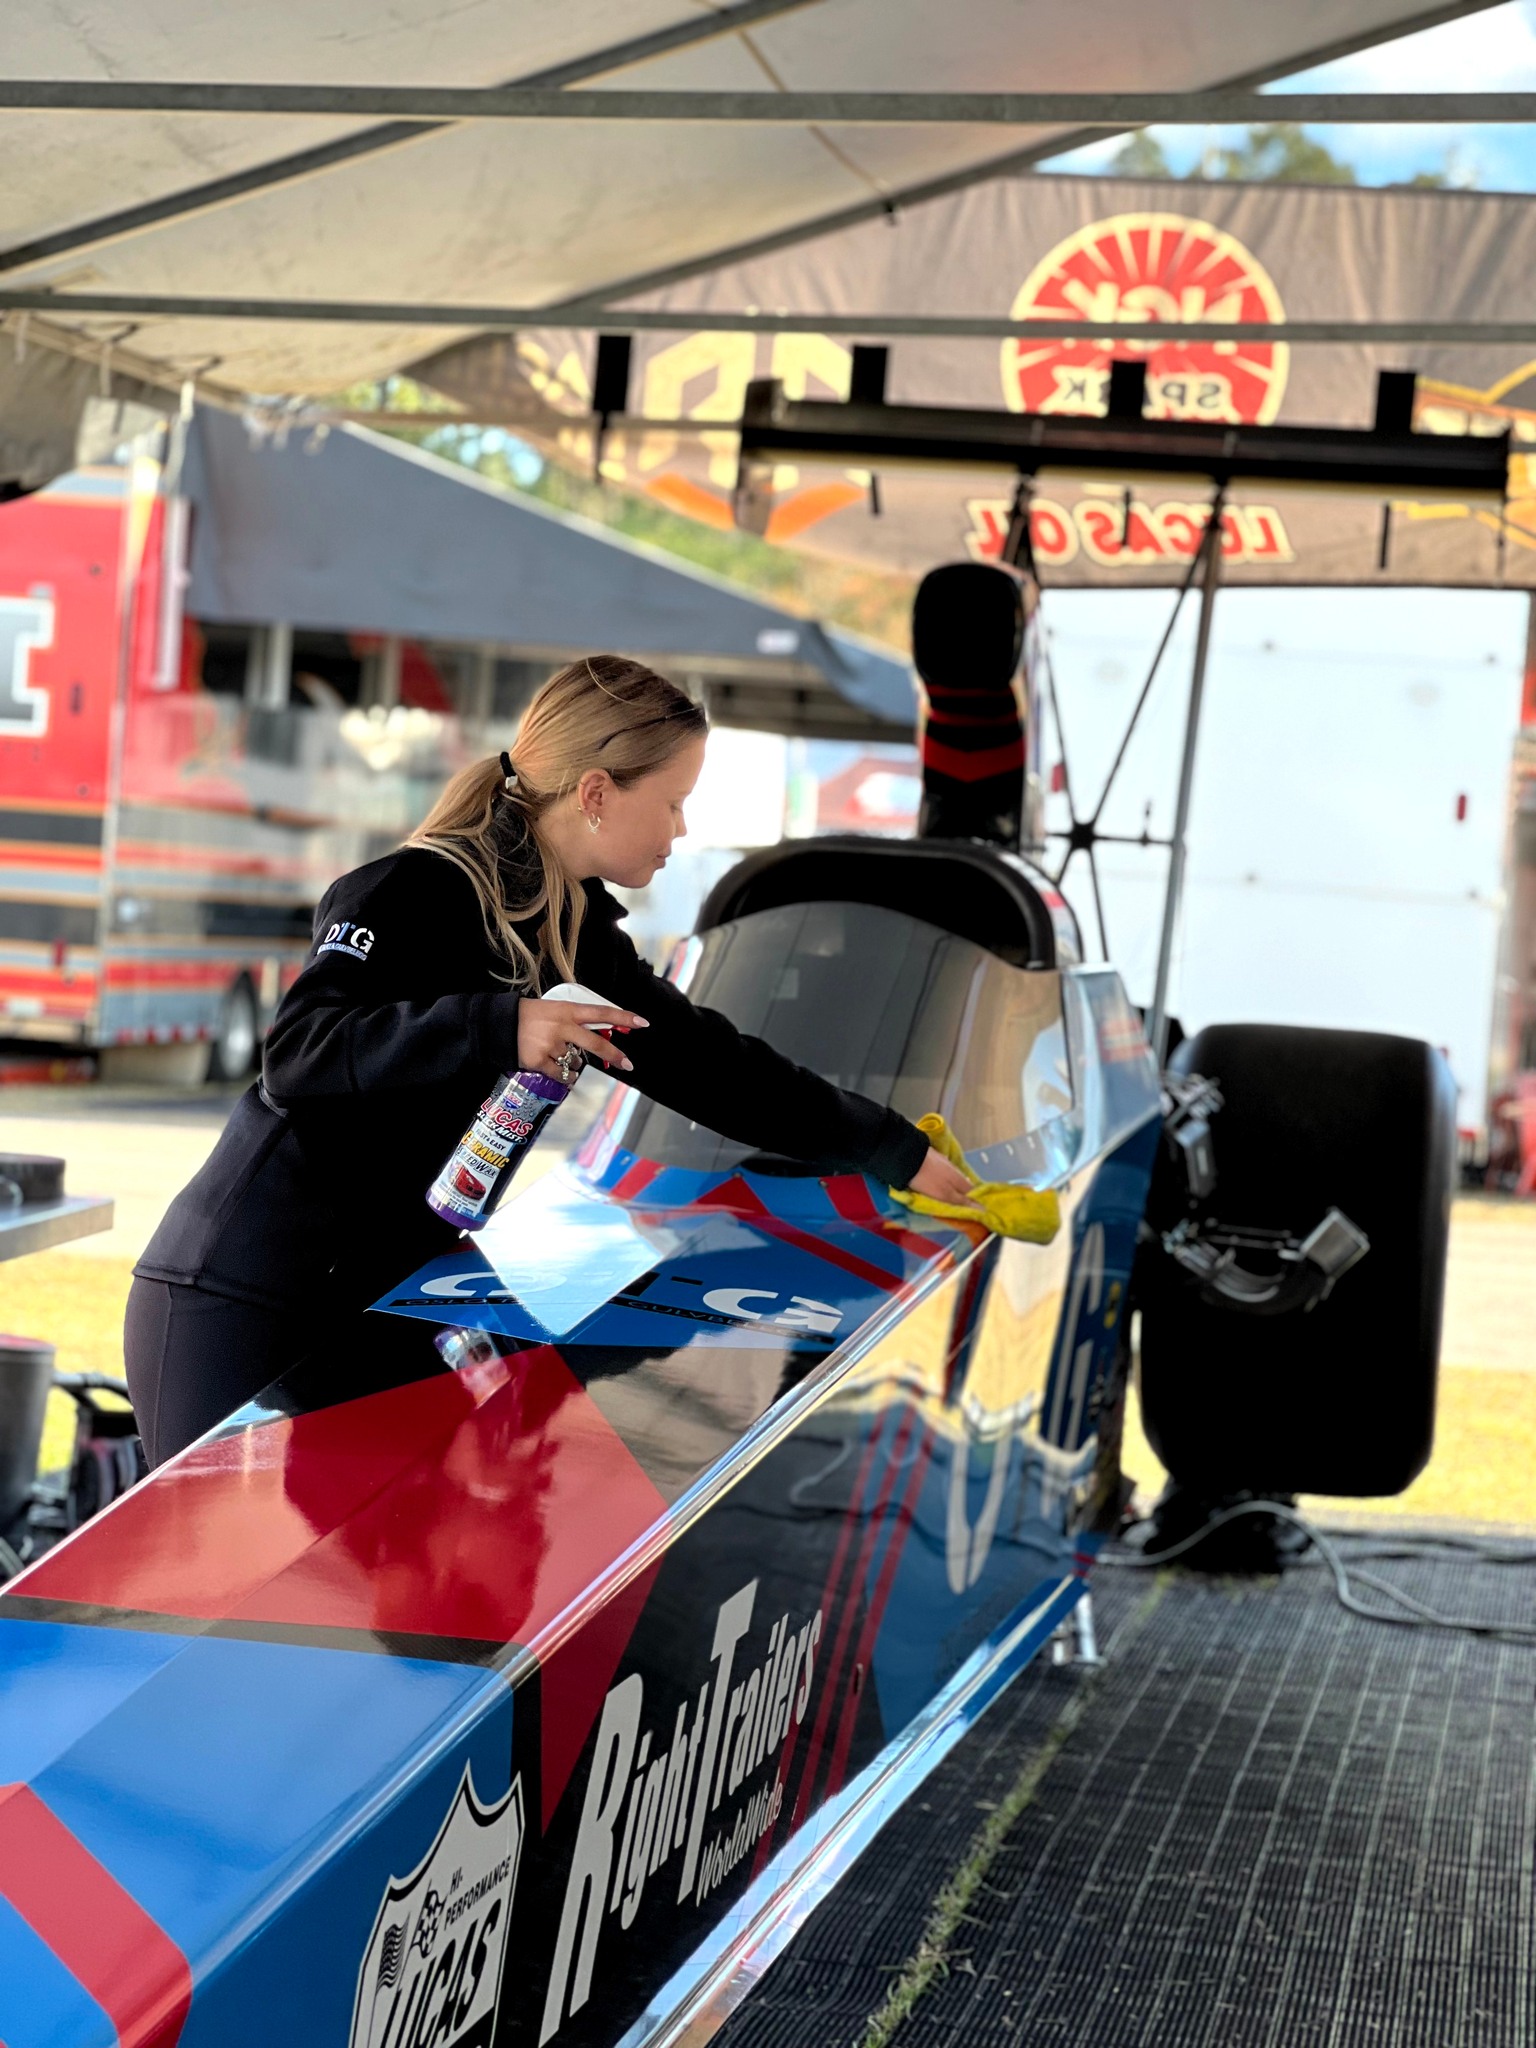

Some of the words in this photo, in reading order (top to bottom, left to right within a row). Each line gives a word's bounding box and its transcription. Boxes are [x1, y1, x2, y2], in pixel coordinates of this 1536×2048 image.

[480, 1096, 533, 1137] LUCAS
[460, 1130, 510, 1169] CERAMIC
[489, 1138, 507, 1151] EASY
[444, 1854, 512, 1931] PERFORMANCE
